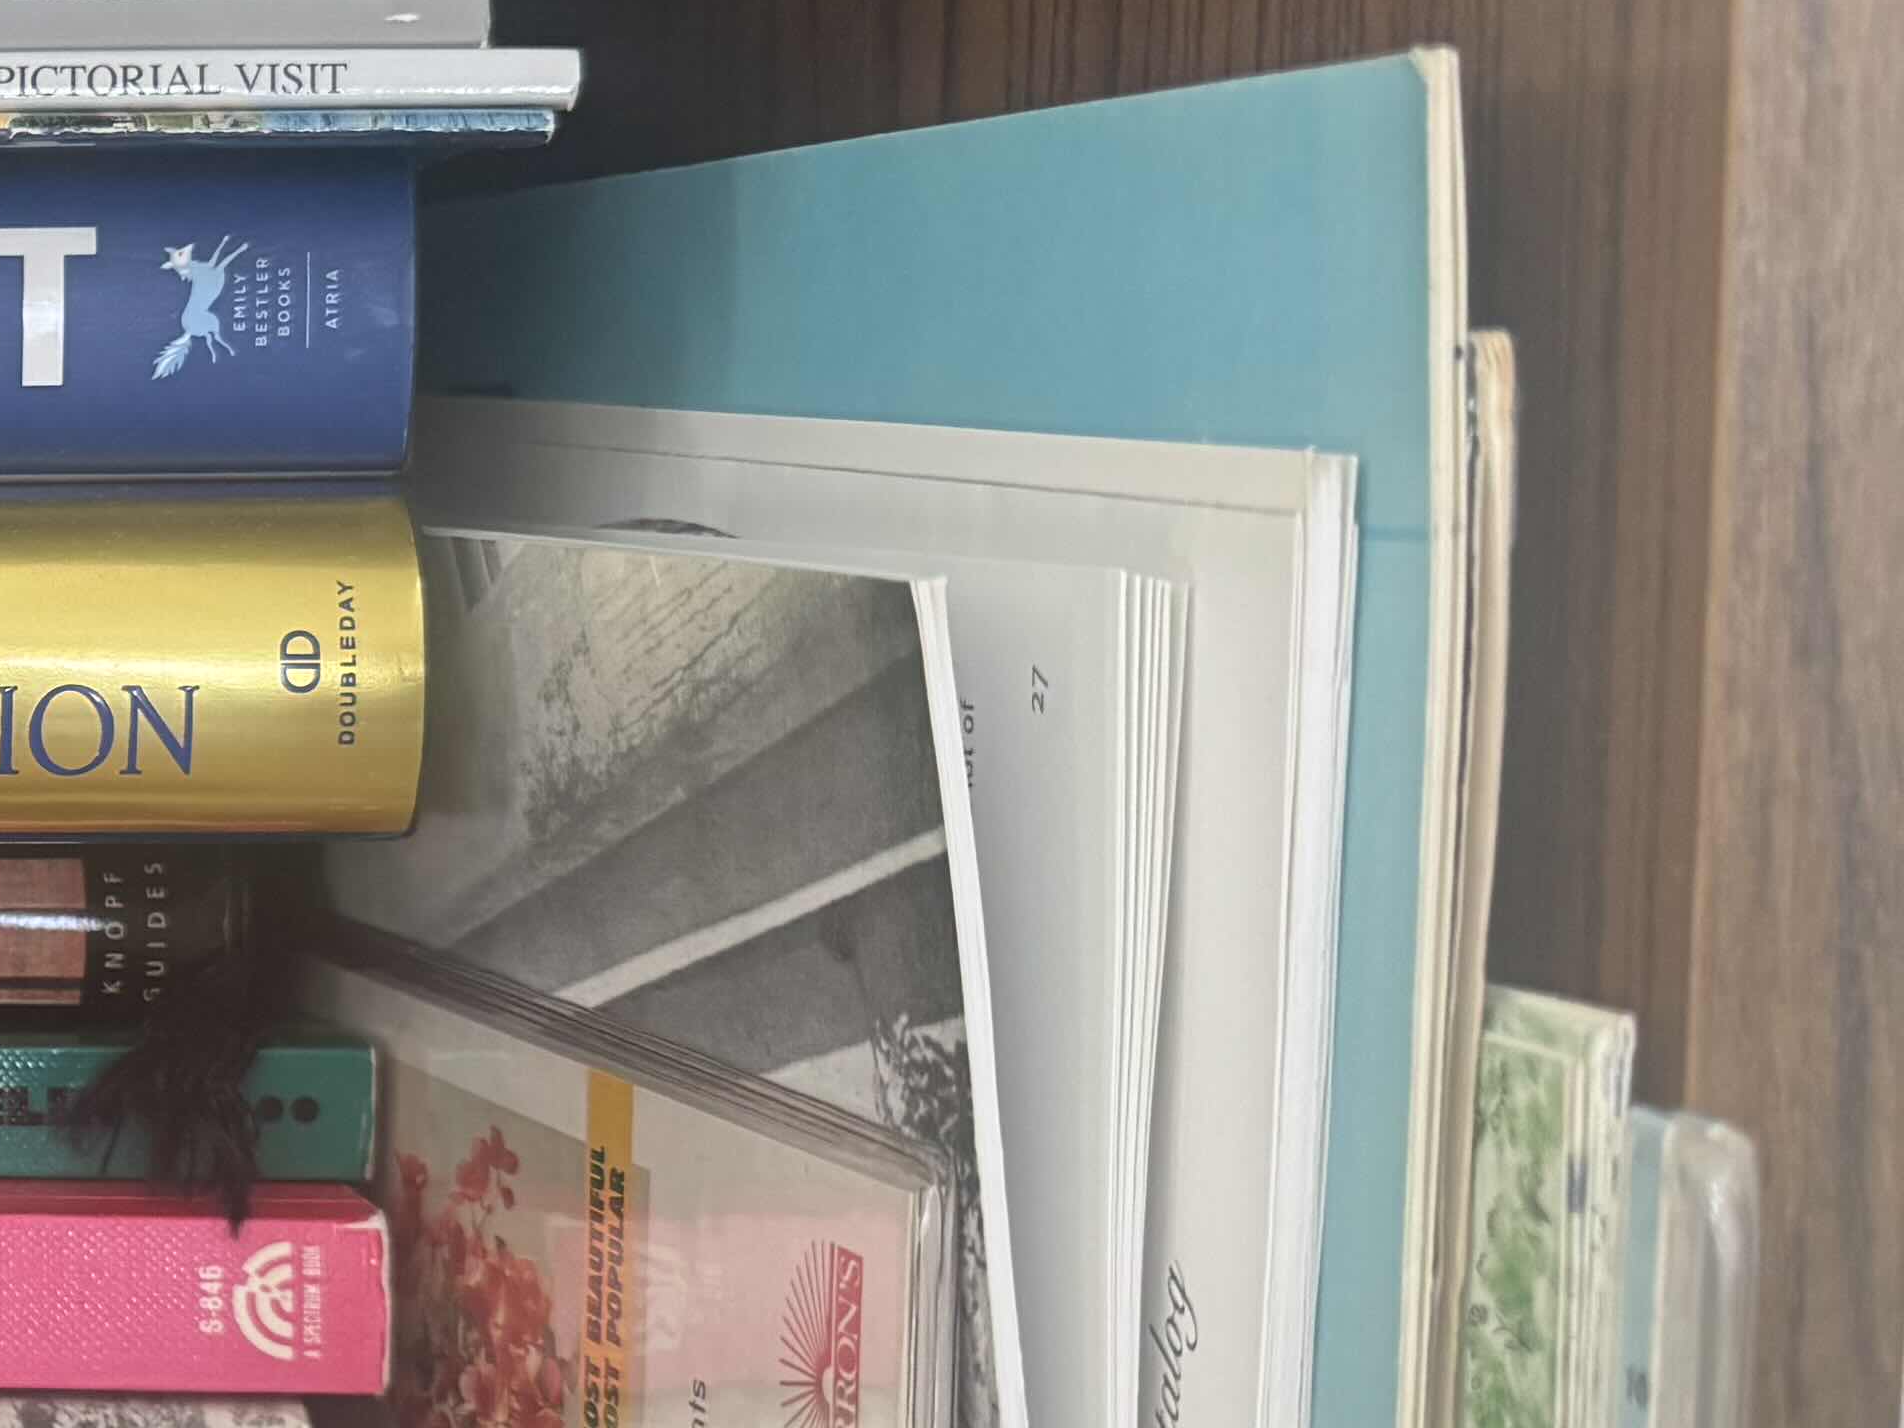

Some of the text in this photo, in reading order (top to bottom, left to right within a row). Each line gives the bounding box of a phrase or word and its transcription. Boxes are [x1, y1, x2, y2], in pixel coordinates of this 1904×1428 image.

[235, 62, 347, 95] VISIT
[233, 273, 247, 332] EMILY
[255, 257, 270, 347] BESTLER
[277, 267, 291, 337] BOOKS
[325, 269, 340, 329] ATRIA
[336, 580, 357, 745] DOUBLEDAY
[1030, 664, 1049, 715] 27
[102, 872, 126, 996] KNOPF
[143, 861, 170, 1003] GUIDES
[588, 1145, 607, 1345] BEAUTIFUL
[607, 1168, 626, 1348] POPULAR
